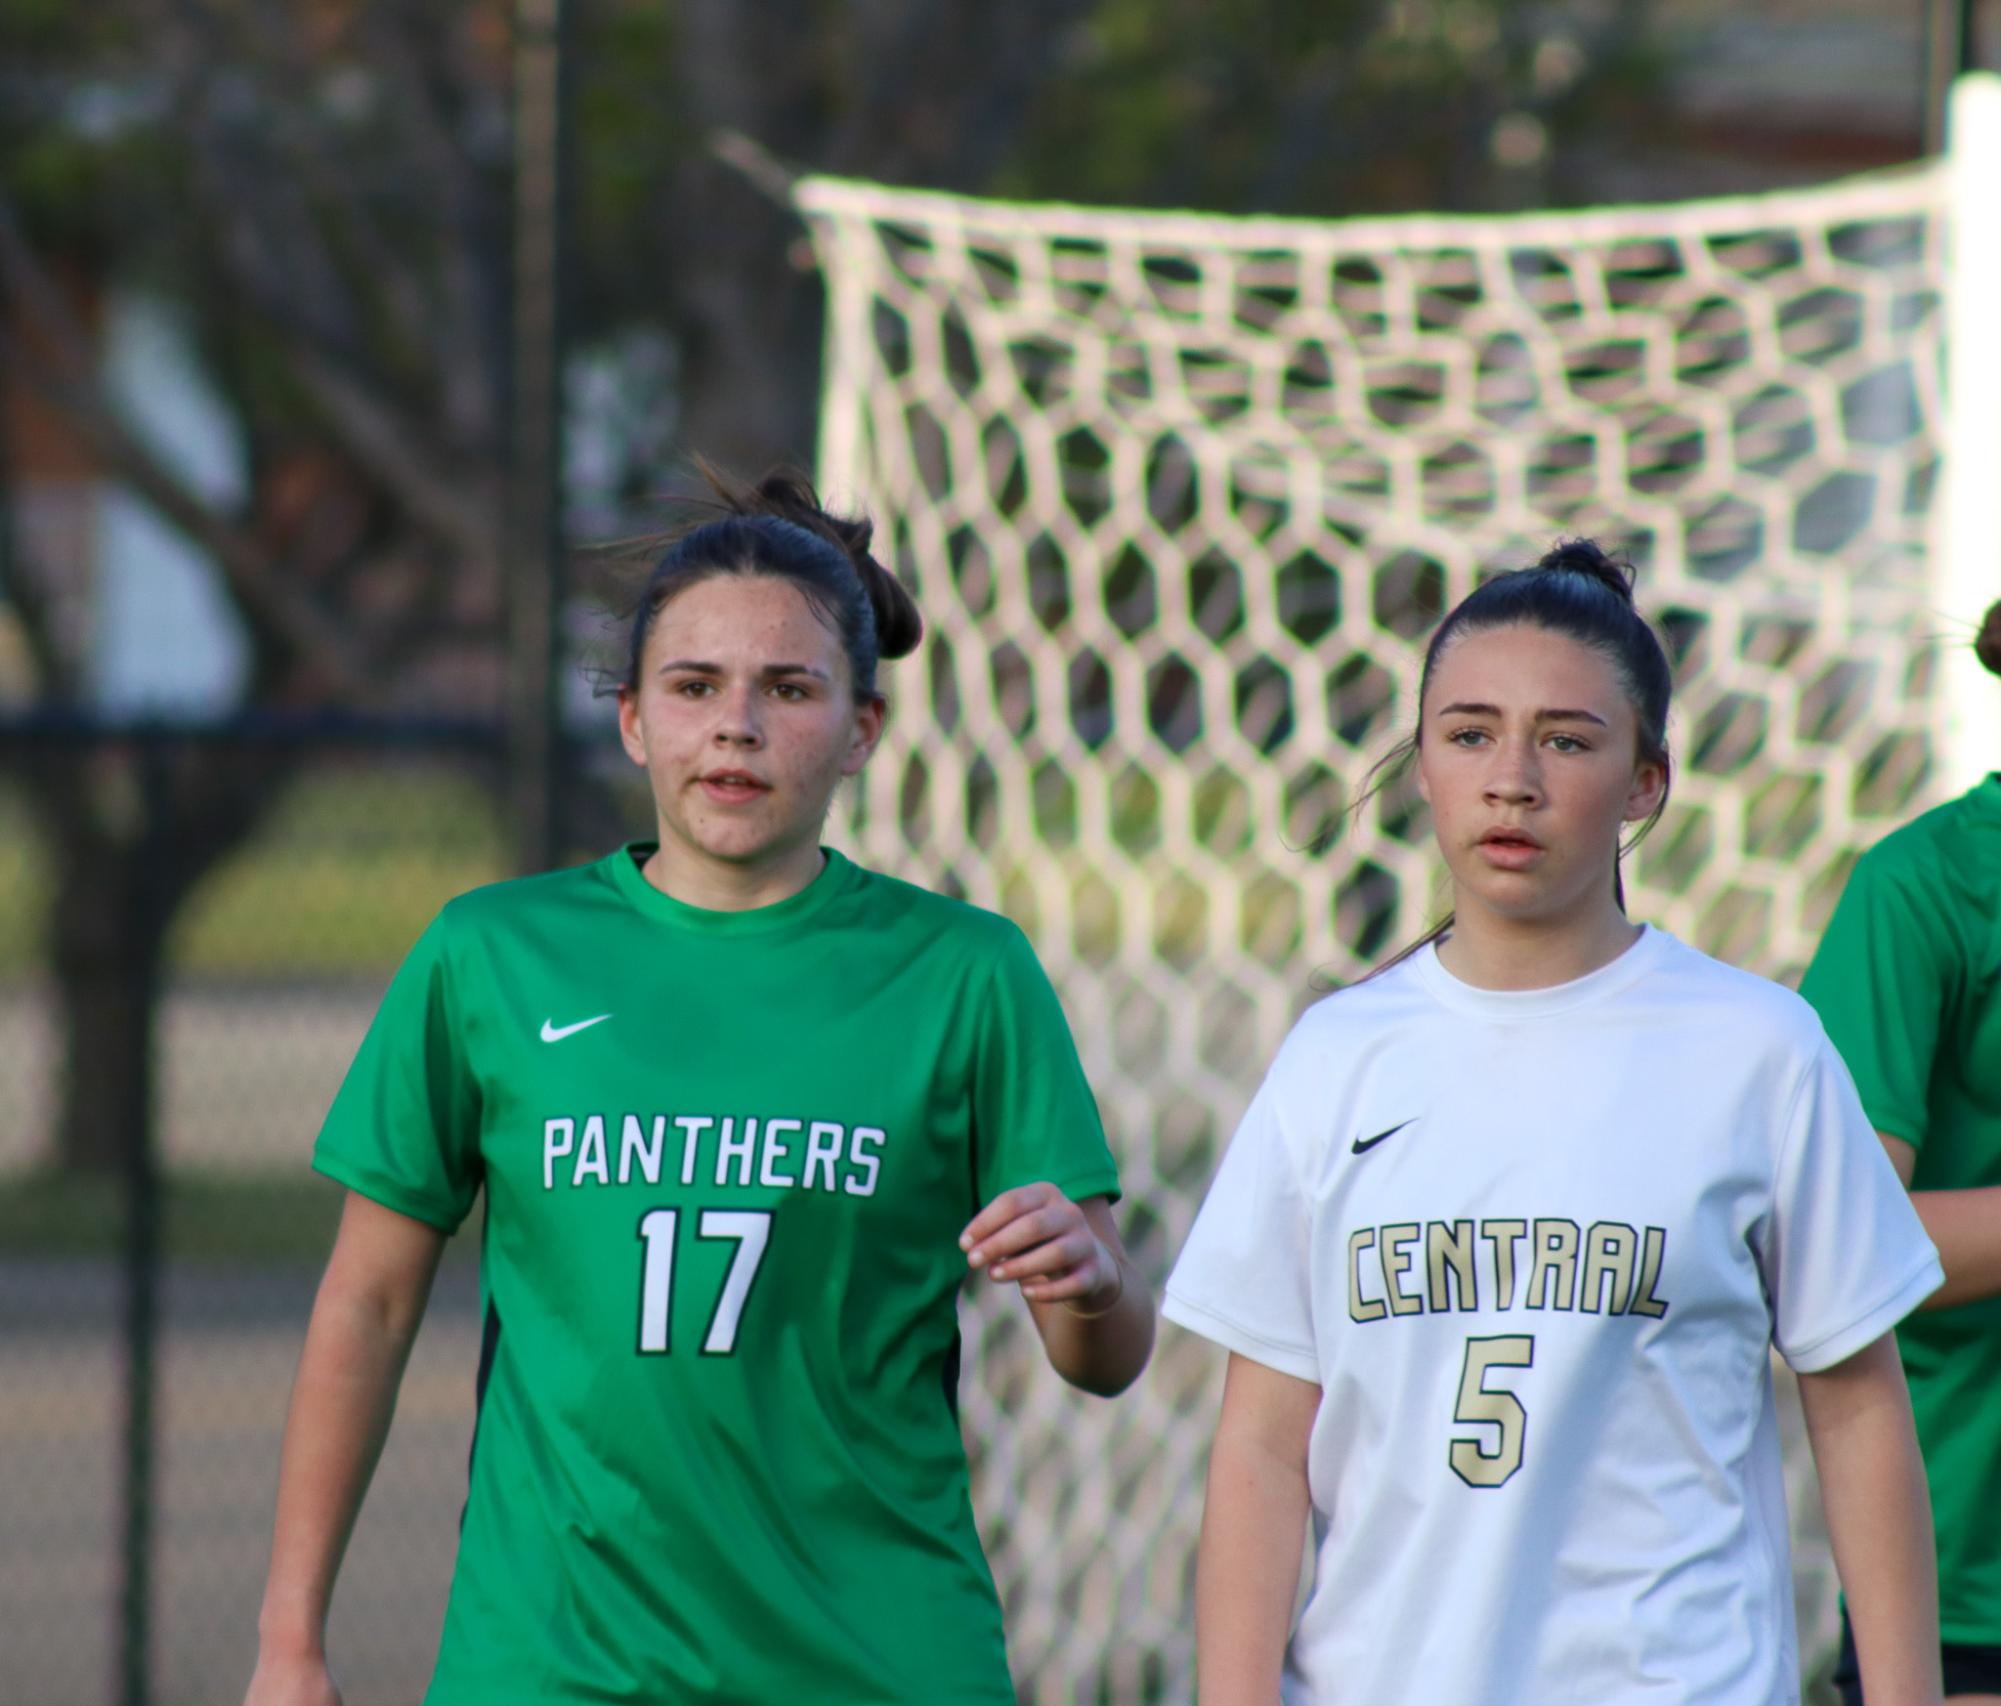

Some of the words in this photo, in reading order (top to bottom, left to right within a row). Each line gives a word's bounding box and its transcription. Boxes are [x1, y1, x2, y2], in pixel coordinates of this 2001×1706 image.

[543, 1114, 887, 1197] PANTHERS
[636, 1206, 775, 1356] 17
[1349, 1218, 1669, 1324] CENTRAL
[1449, 1334, 1534, 1488] 5
